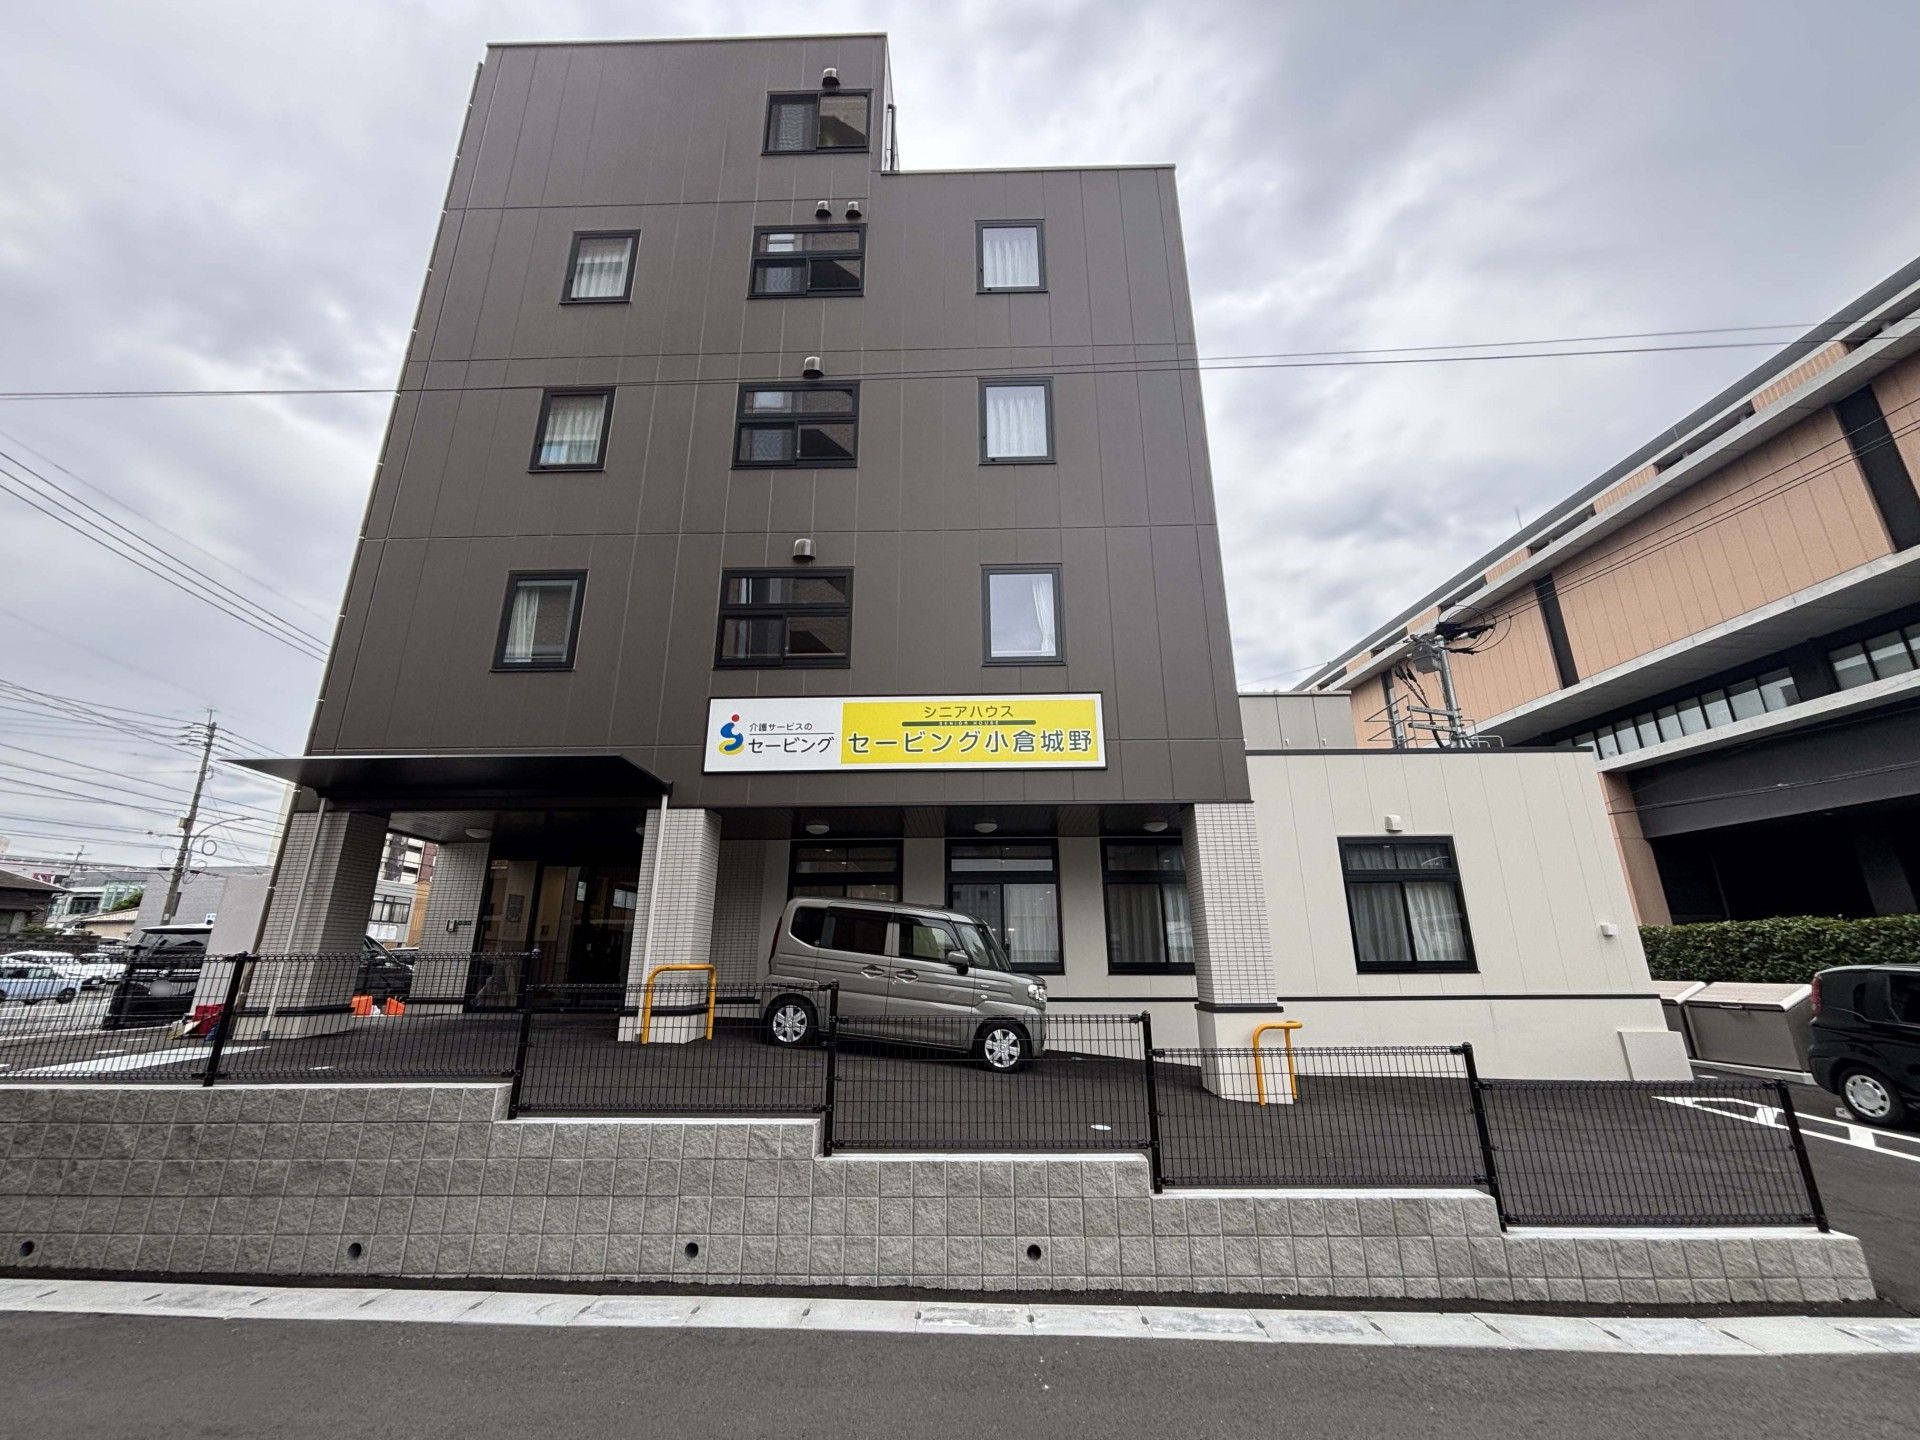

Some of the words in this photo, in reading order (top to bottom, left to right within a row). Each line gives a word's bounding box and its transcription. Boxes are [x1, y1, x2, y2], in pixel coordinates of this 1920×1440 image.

[923, 705, 1014, 719] シニアハウス
[749, 722, 813, 732] 介護サービスの
[748, 736, 835, 754] セービング
[848, 729, 1092, 754] セービング小倉城野
